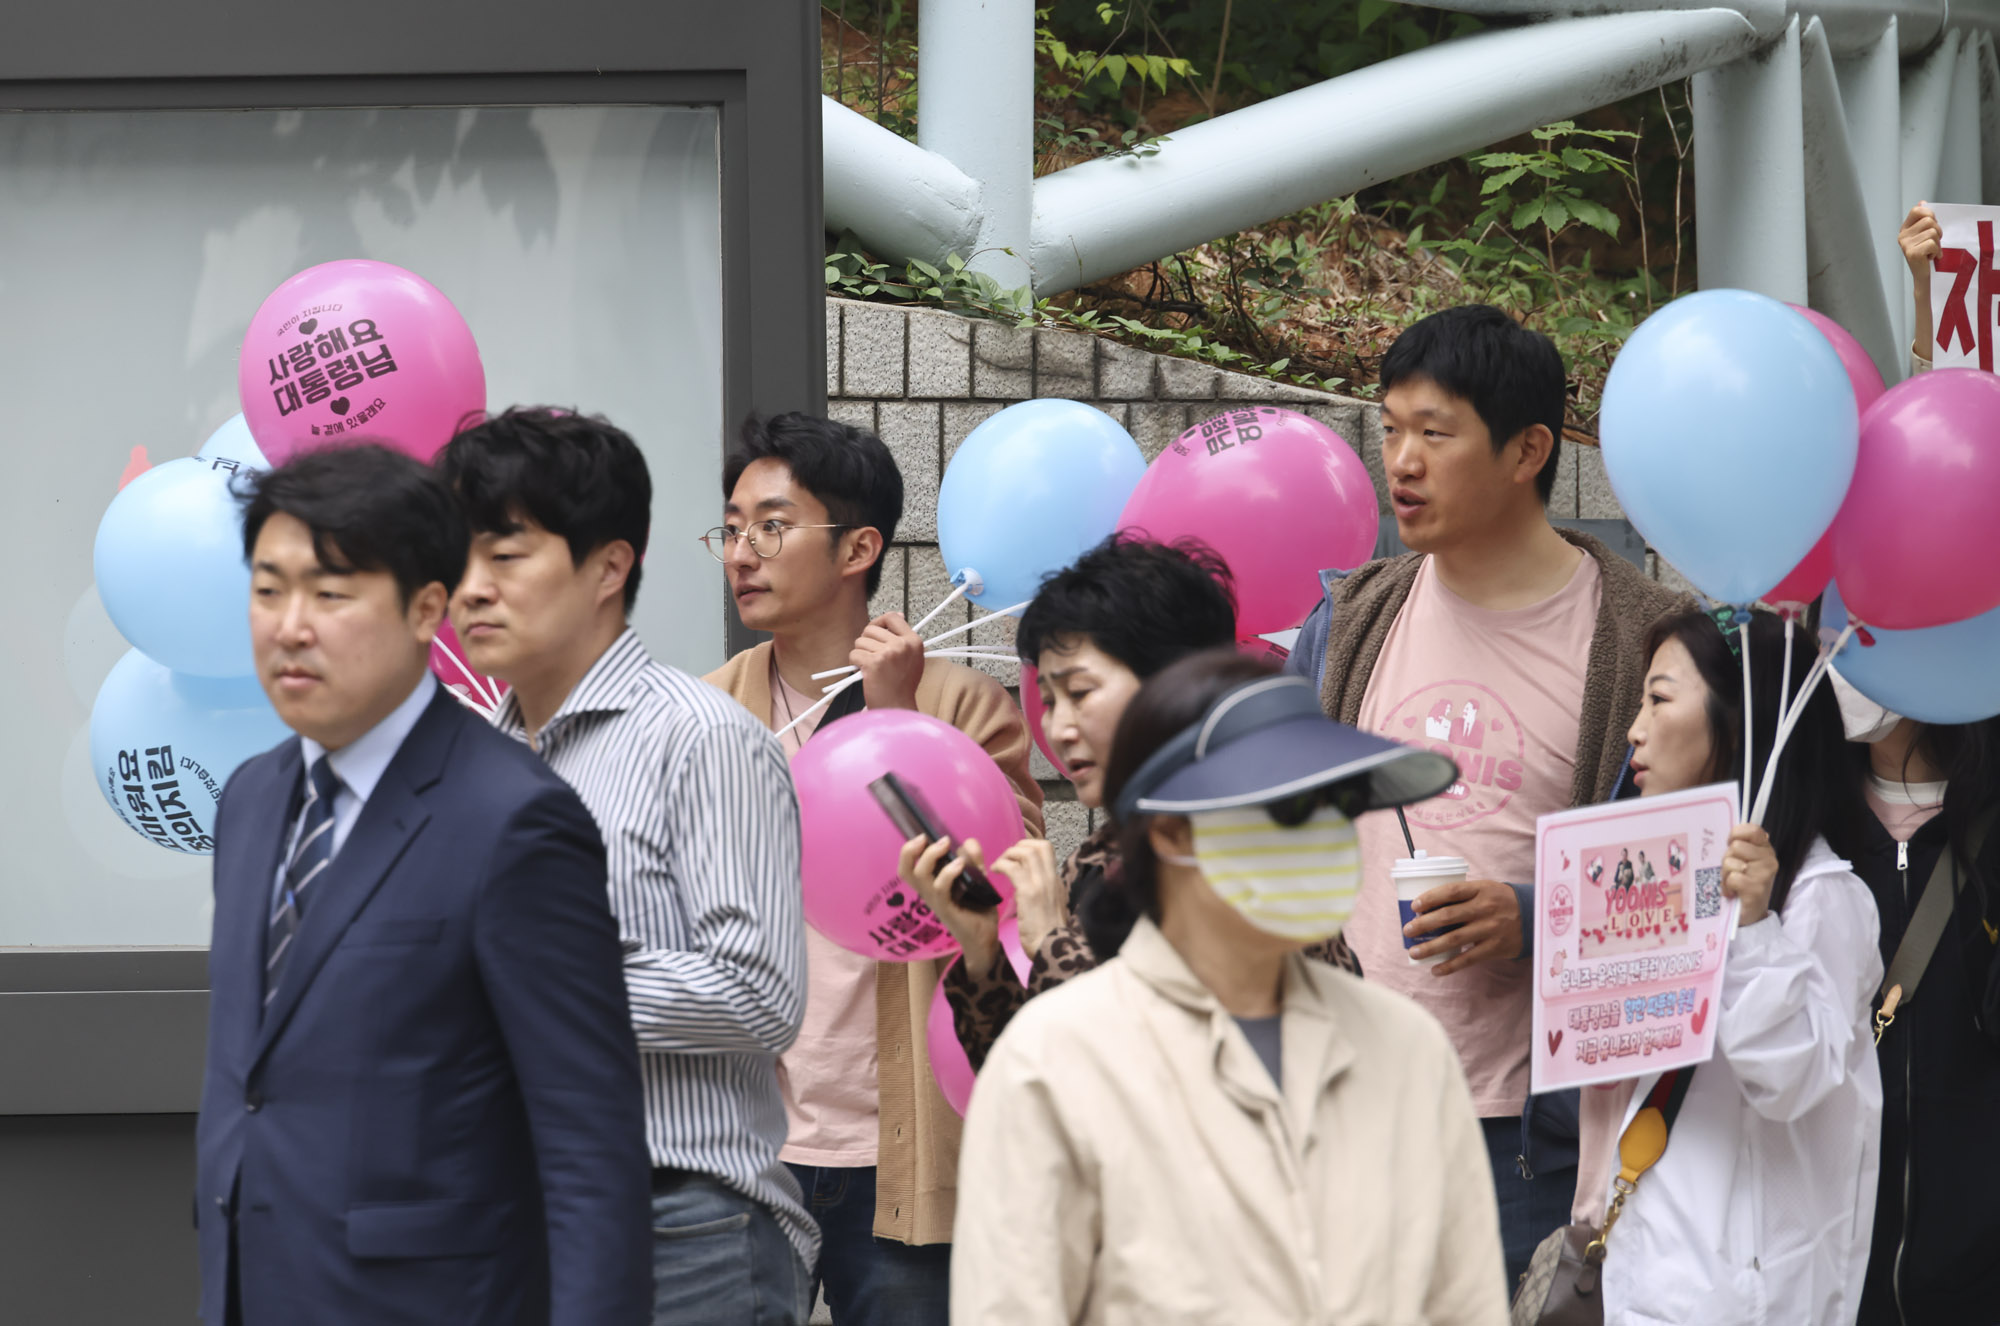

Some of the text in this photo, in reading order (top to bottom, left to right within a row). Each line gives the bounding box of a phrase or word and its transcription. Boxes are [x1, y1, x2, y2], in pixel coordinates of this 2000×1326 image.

[302, 303, 343, 319] 지킵니다
[268, 318, 384, 386] 사랑해요
[273, 344, 398, 417] 대통령님
[118, 748, 188, 852] 고마워요
[145, 745, 215, 852] 정의지킴
[180, 756, 222, 808] 되었습니다
[1604, 880, 1669, 916] YOONIS
[1611, 908, 1673, 930] LOVE
[1660, 950, 1703, 977] YOONIS
[1568, 1000, 1621, 1033] 대통령님을
[1576, 1037, 1598, 1065] 지금
[1599, 1031, 1641, 1062] 유니즈와
